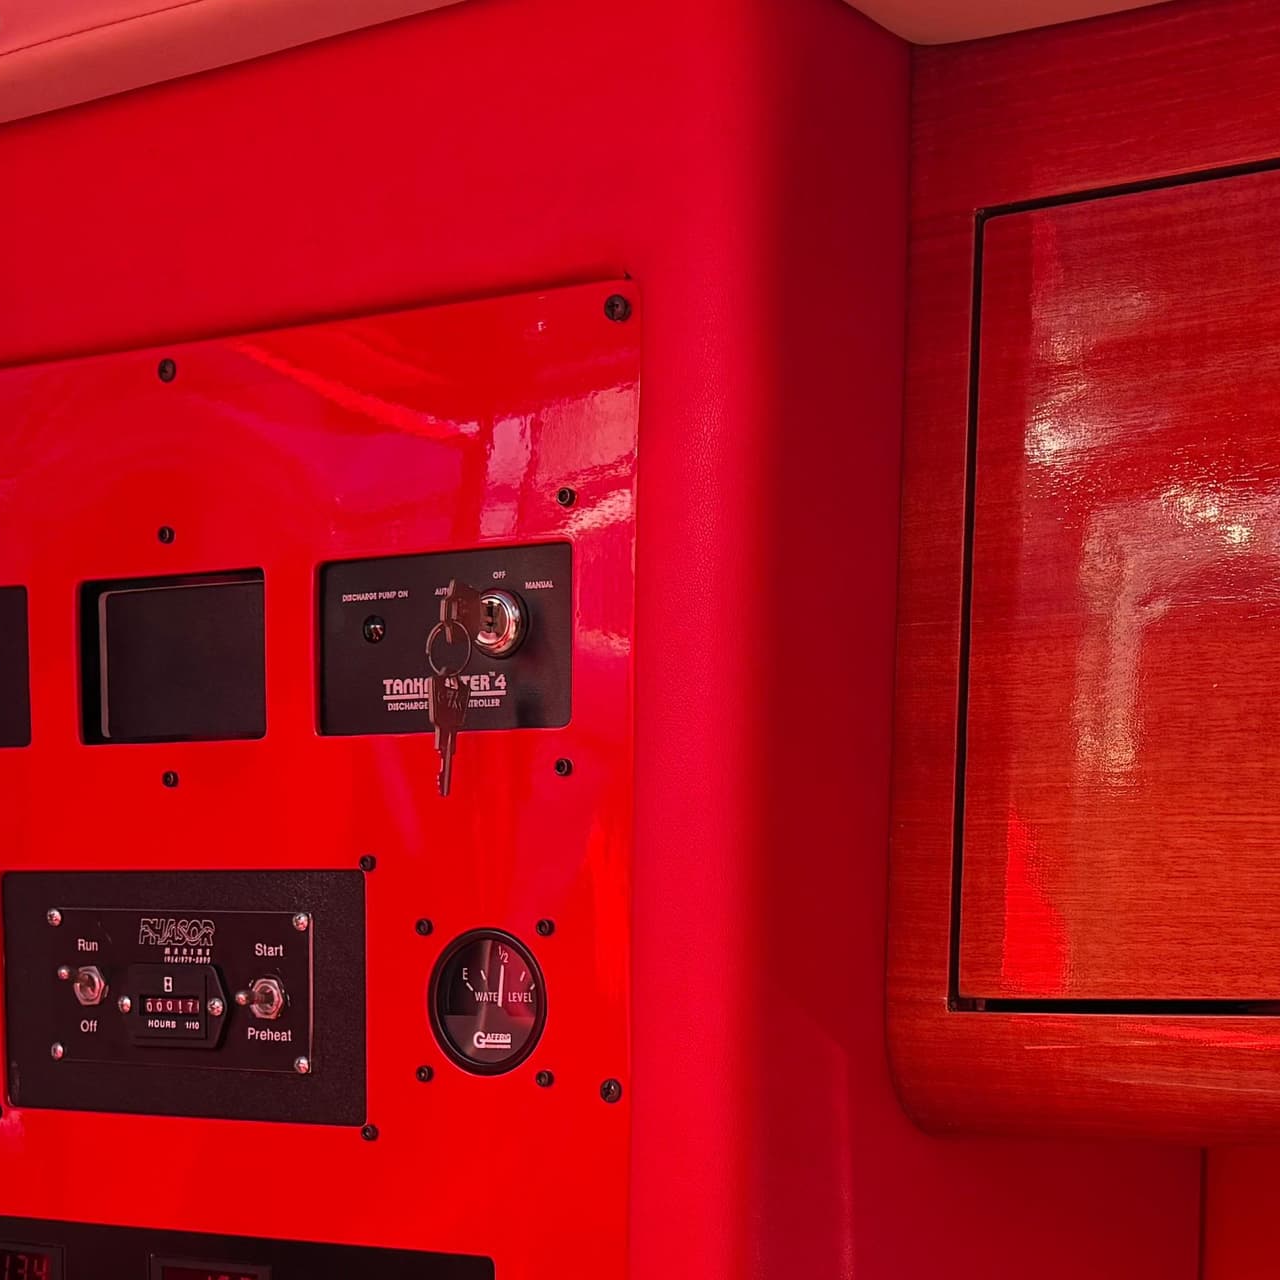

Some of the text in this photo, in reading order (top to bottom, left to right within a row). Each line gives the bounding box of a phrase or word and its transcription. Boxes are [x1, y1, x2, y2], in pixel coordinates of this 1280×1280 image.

[492, 571, 506, 579] OFF
[525, 580, 554, 590] MANUAL
[342, 590, 408, 602] DISCHARGE PUMP ON
[495, 674, 506, 690] 4
[139, 918, 215, 946] PHASOR
[78, 939, 98, 951] Run
[255, 943, 284, 957] Start
[164, 947, 210, 956] MARINE
[462, 967, 468, 980] E
[508, 992, 532, 1003] LEVEL
[80, 1020, 97, 1032] Off
[148, 1019, 200, 1030] HOURS 1/10
[248, 1027, 292, 1042] Preheat
